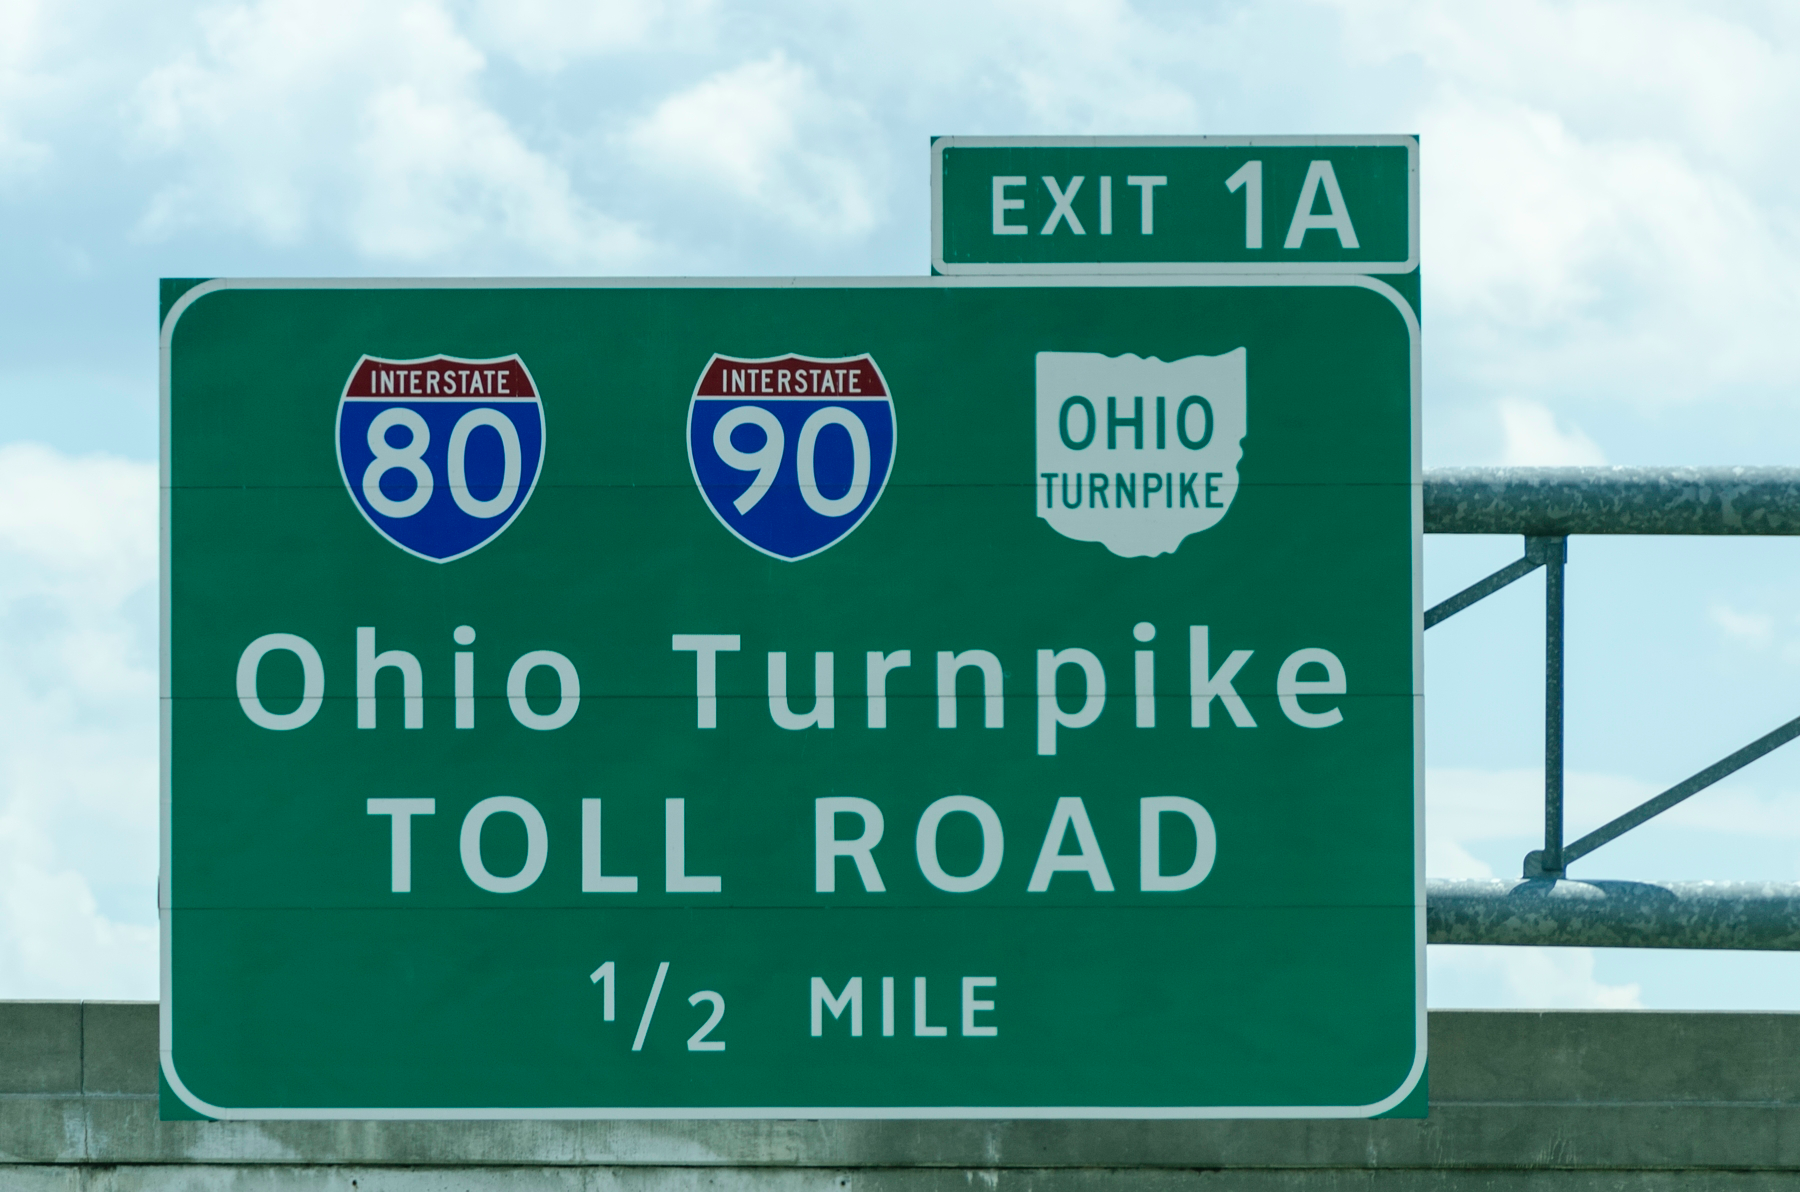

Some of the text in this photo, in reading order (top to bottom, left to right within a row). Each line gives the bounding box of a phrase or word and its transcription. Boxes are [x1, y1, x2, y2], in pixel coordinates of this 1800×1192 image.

[992, 160, 1360, 249] EXIT 1A
[370, 368, 511, 395] INTERSTATE
[721, 368, 862, 394] INTERSTATE
[1058, 395, 1214, 451] OHIO
[362, 407, 522, 518] 80
[713, 405, 871, 517] 90
[1041, 472, 1224, 509] TURNPIKE
[236, 622, 1347, 755] Ohio Turnpike
[367, 795, 1217, 893] TOLL ROAD
[590, 961, 998, 1051] 1/2 MILE
